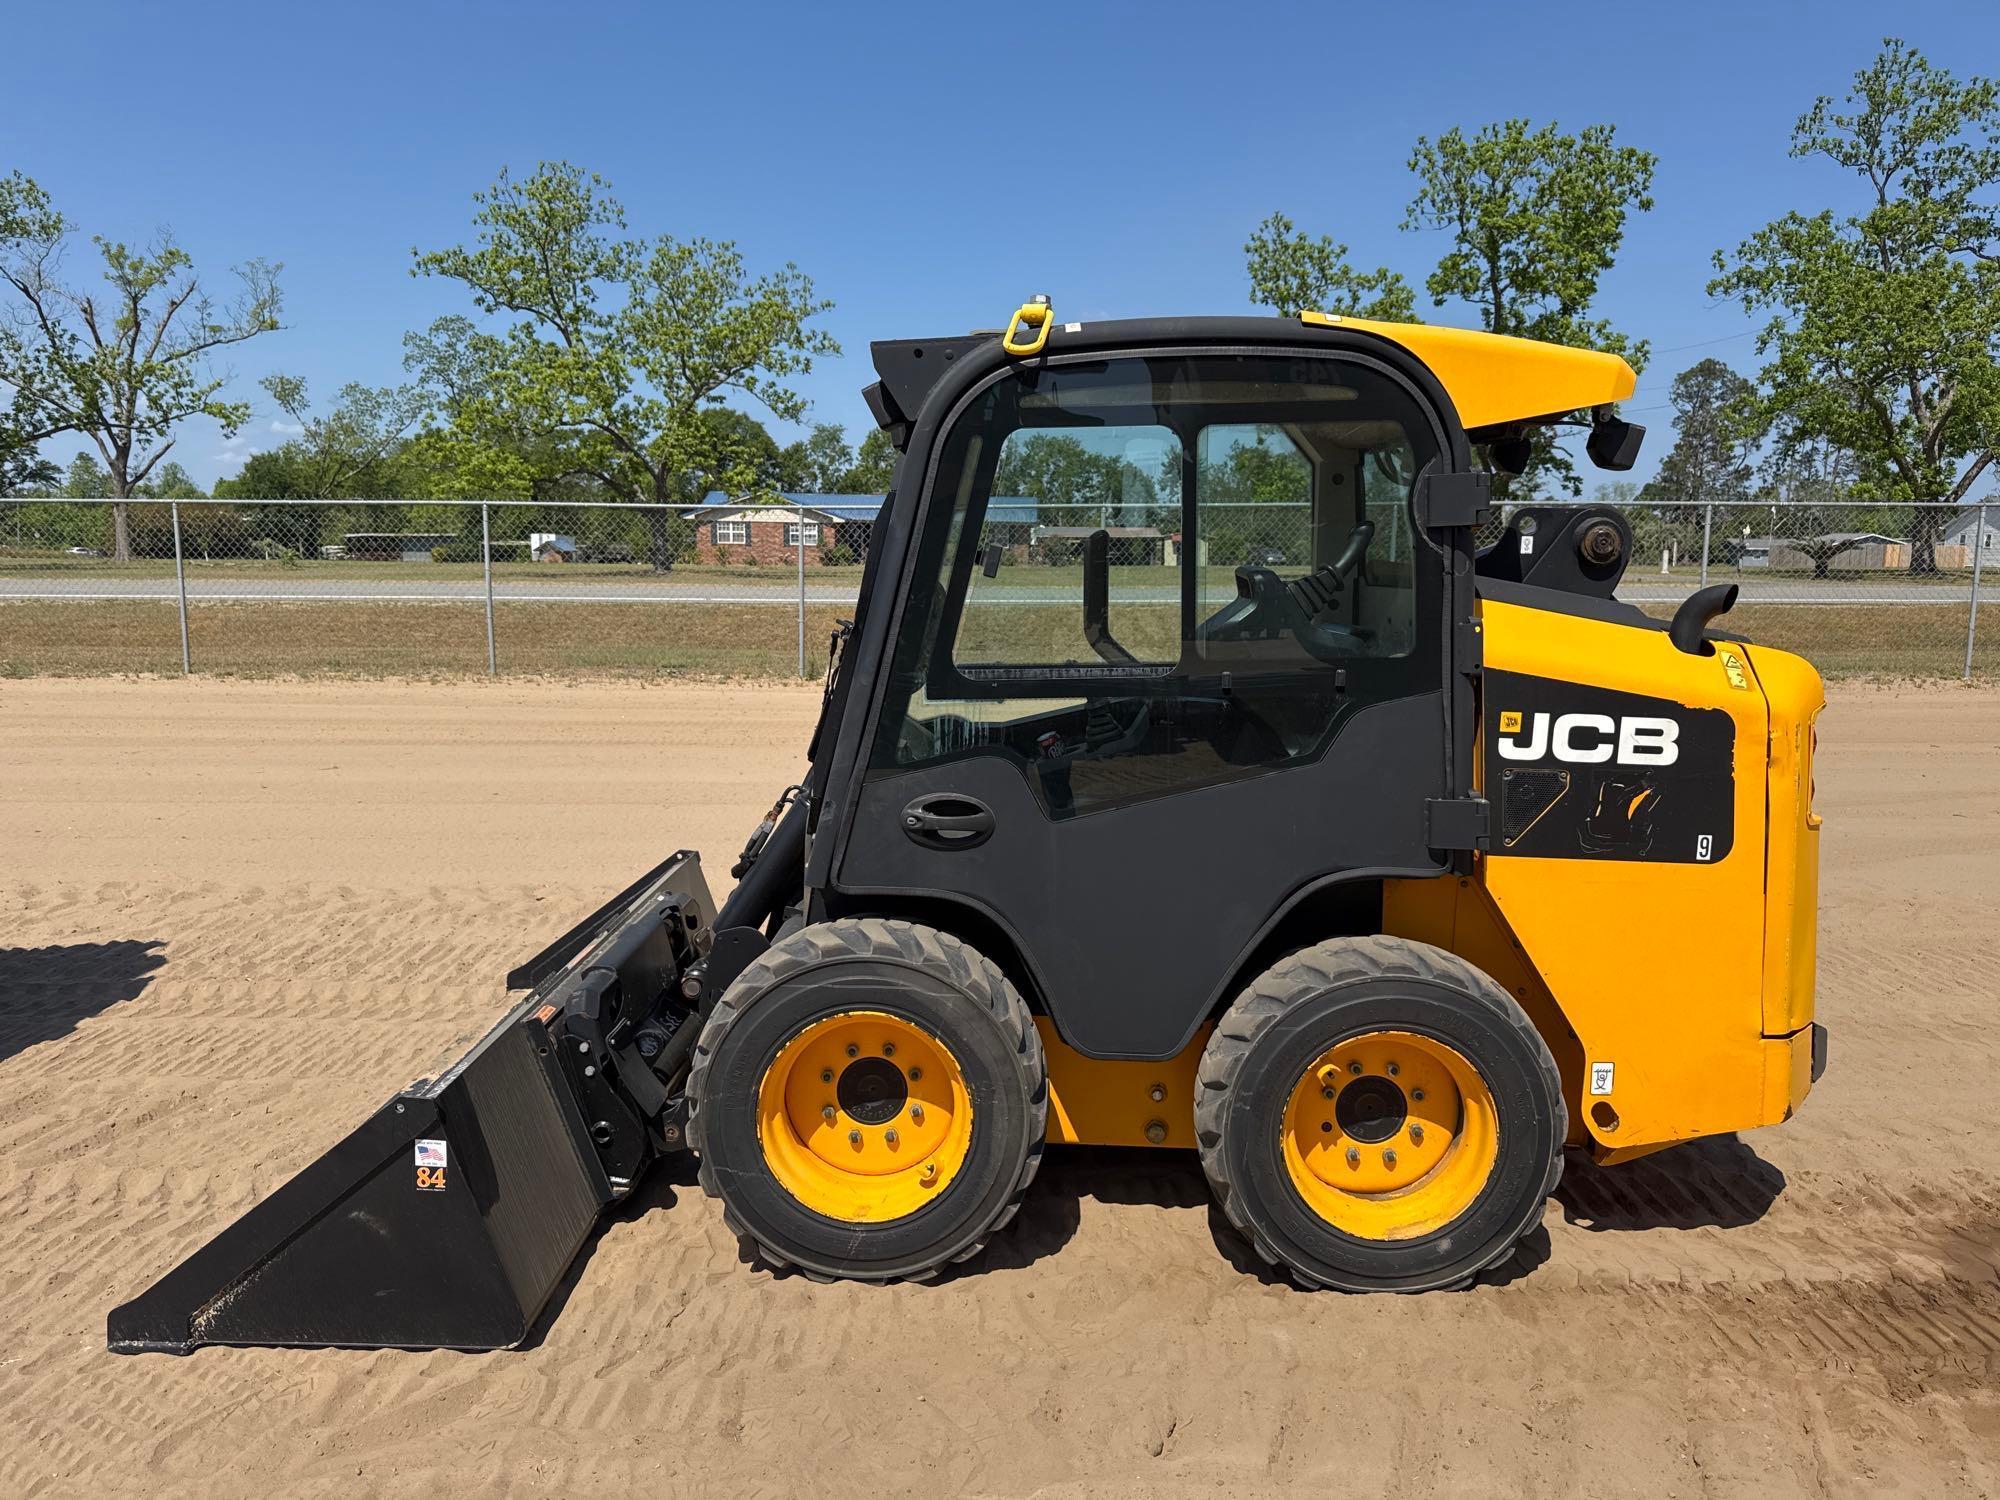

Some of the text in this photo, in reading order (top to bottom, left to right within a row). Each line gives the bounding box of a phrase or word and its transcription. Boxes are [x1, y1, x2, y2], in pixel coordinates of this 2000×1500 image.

[1498, 713, 1680, 766] JCB
[1699, 836, 1710, 858] 9
[416, 1167, 446, 1189] 84
